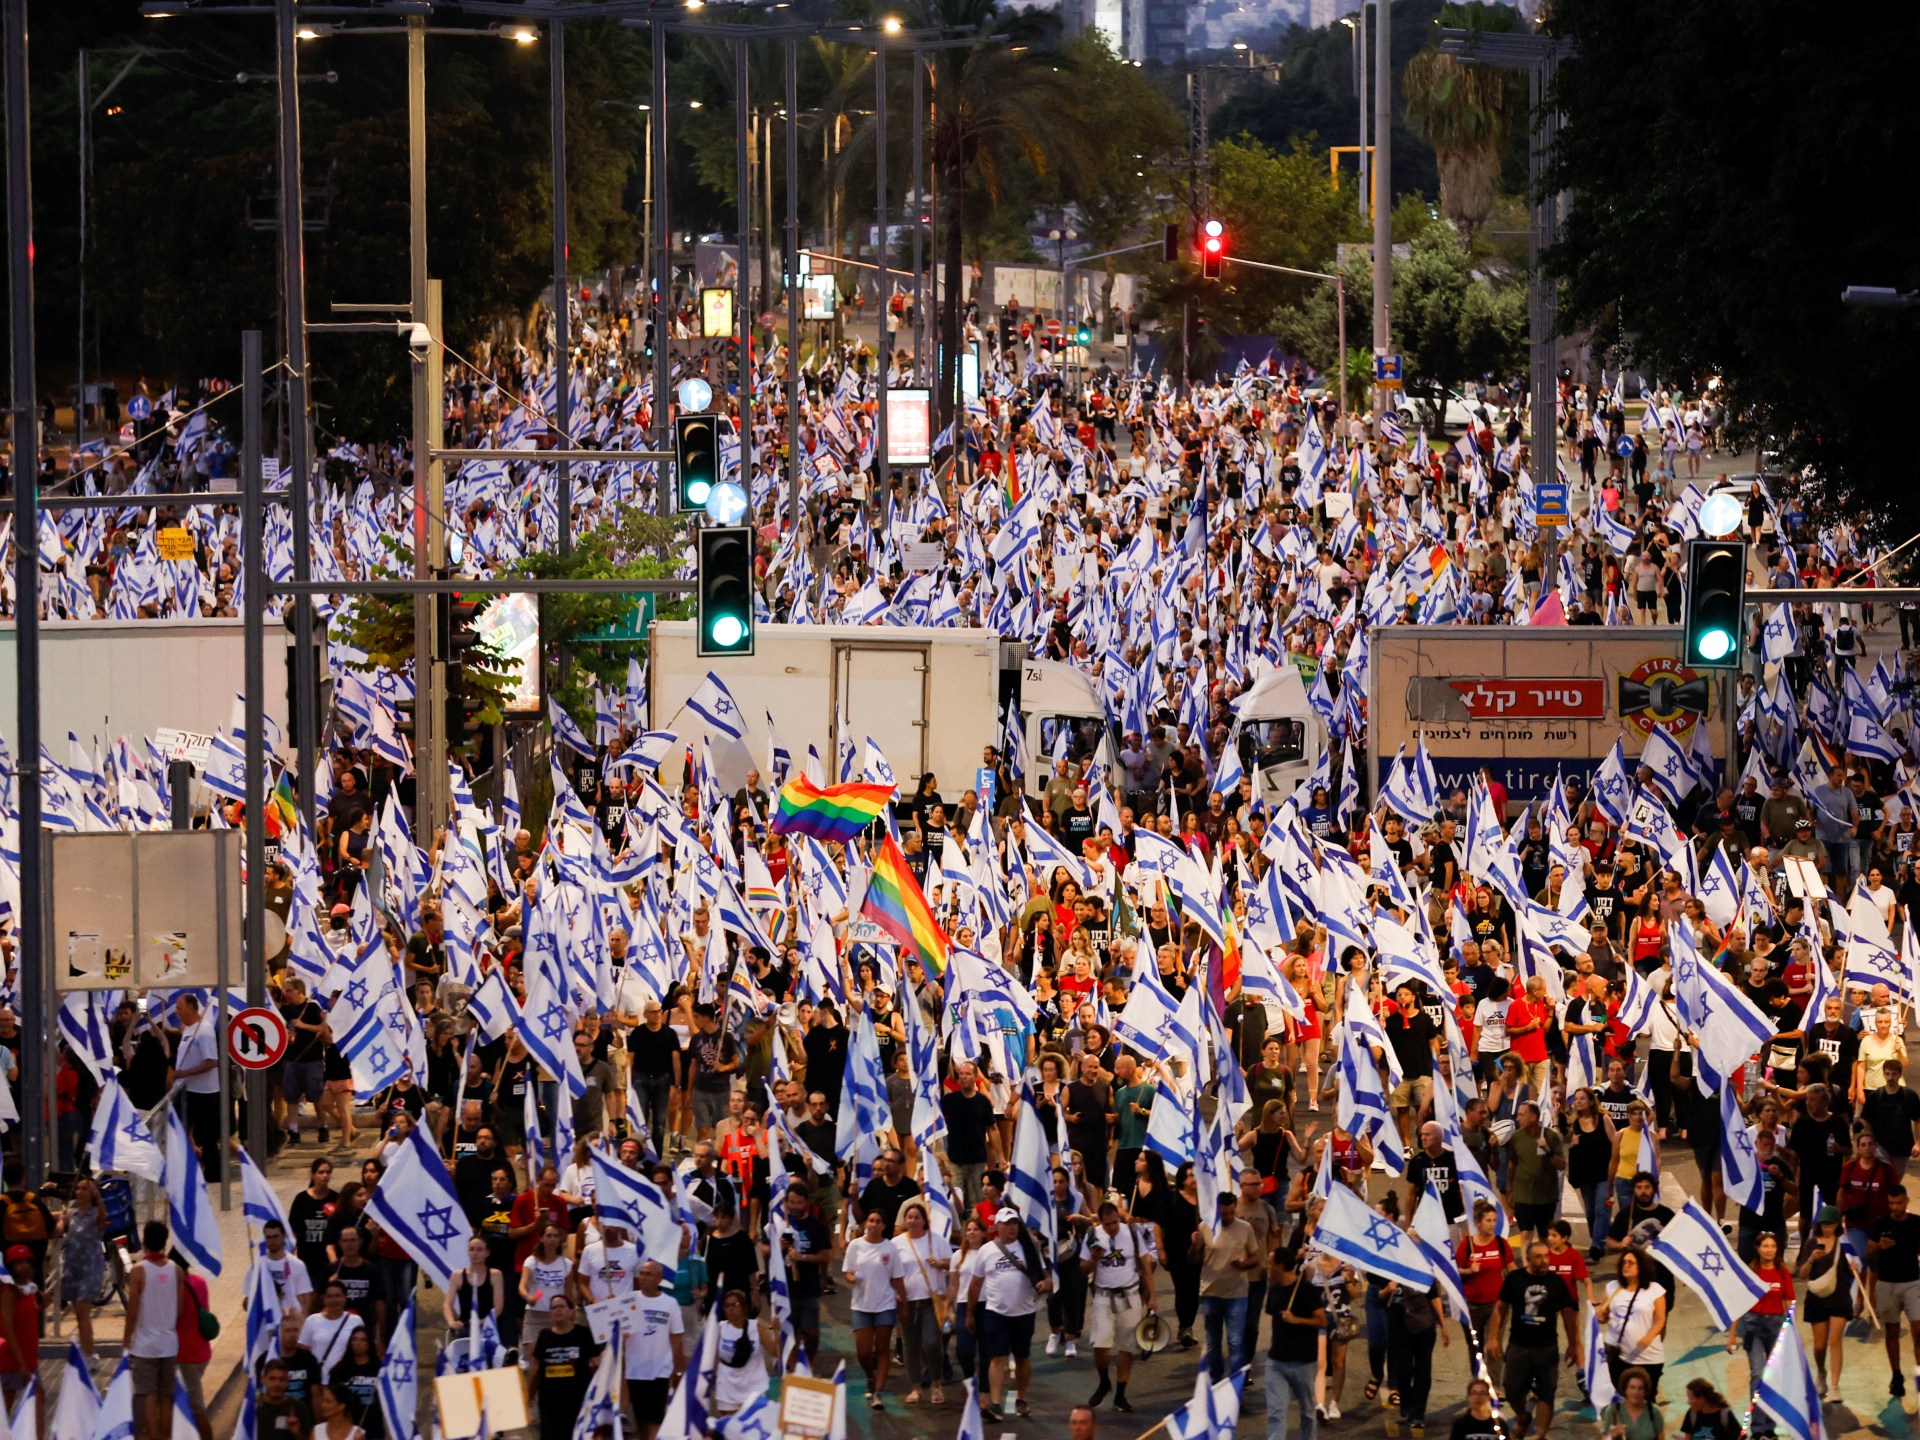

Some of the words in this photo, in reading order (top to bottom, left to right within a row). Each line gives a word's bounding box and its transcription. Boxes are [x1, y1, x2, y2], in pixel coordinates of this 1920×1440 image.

[1641, 659, 1684, 675] TIRE
[1025, 668, 1039, 681] 7.5
[1528, 689, 1583, 707] טייר
[1639, 717, 1688, 734] CUB
[1480, 729, 1533, 741] מומחים
[1543, 729, 1577, 741] רשת
[581, 769, 595, 777] דמו
[608, 806, 625, 814] דמו
[1596, 897, 1614, 906] דמו
[1091, 930, 1108, 939] דמו
[1423, 1005, 1442, 1015] דמו
[1819, 1037, 1841, 1050] דמו
[1425, 1166, 1449, 1179] דמו
